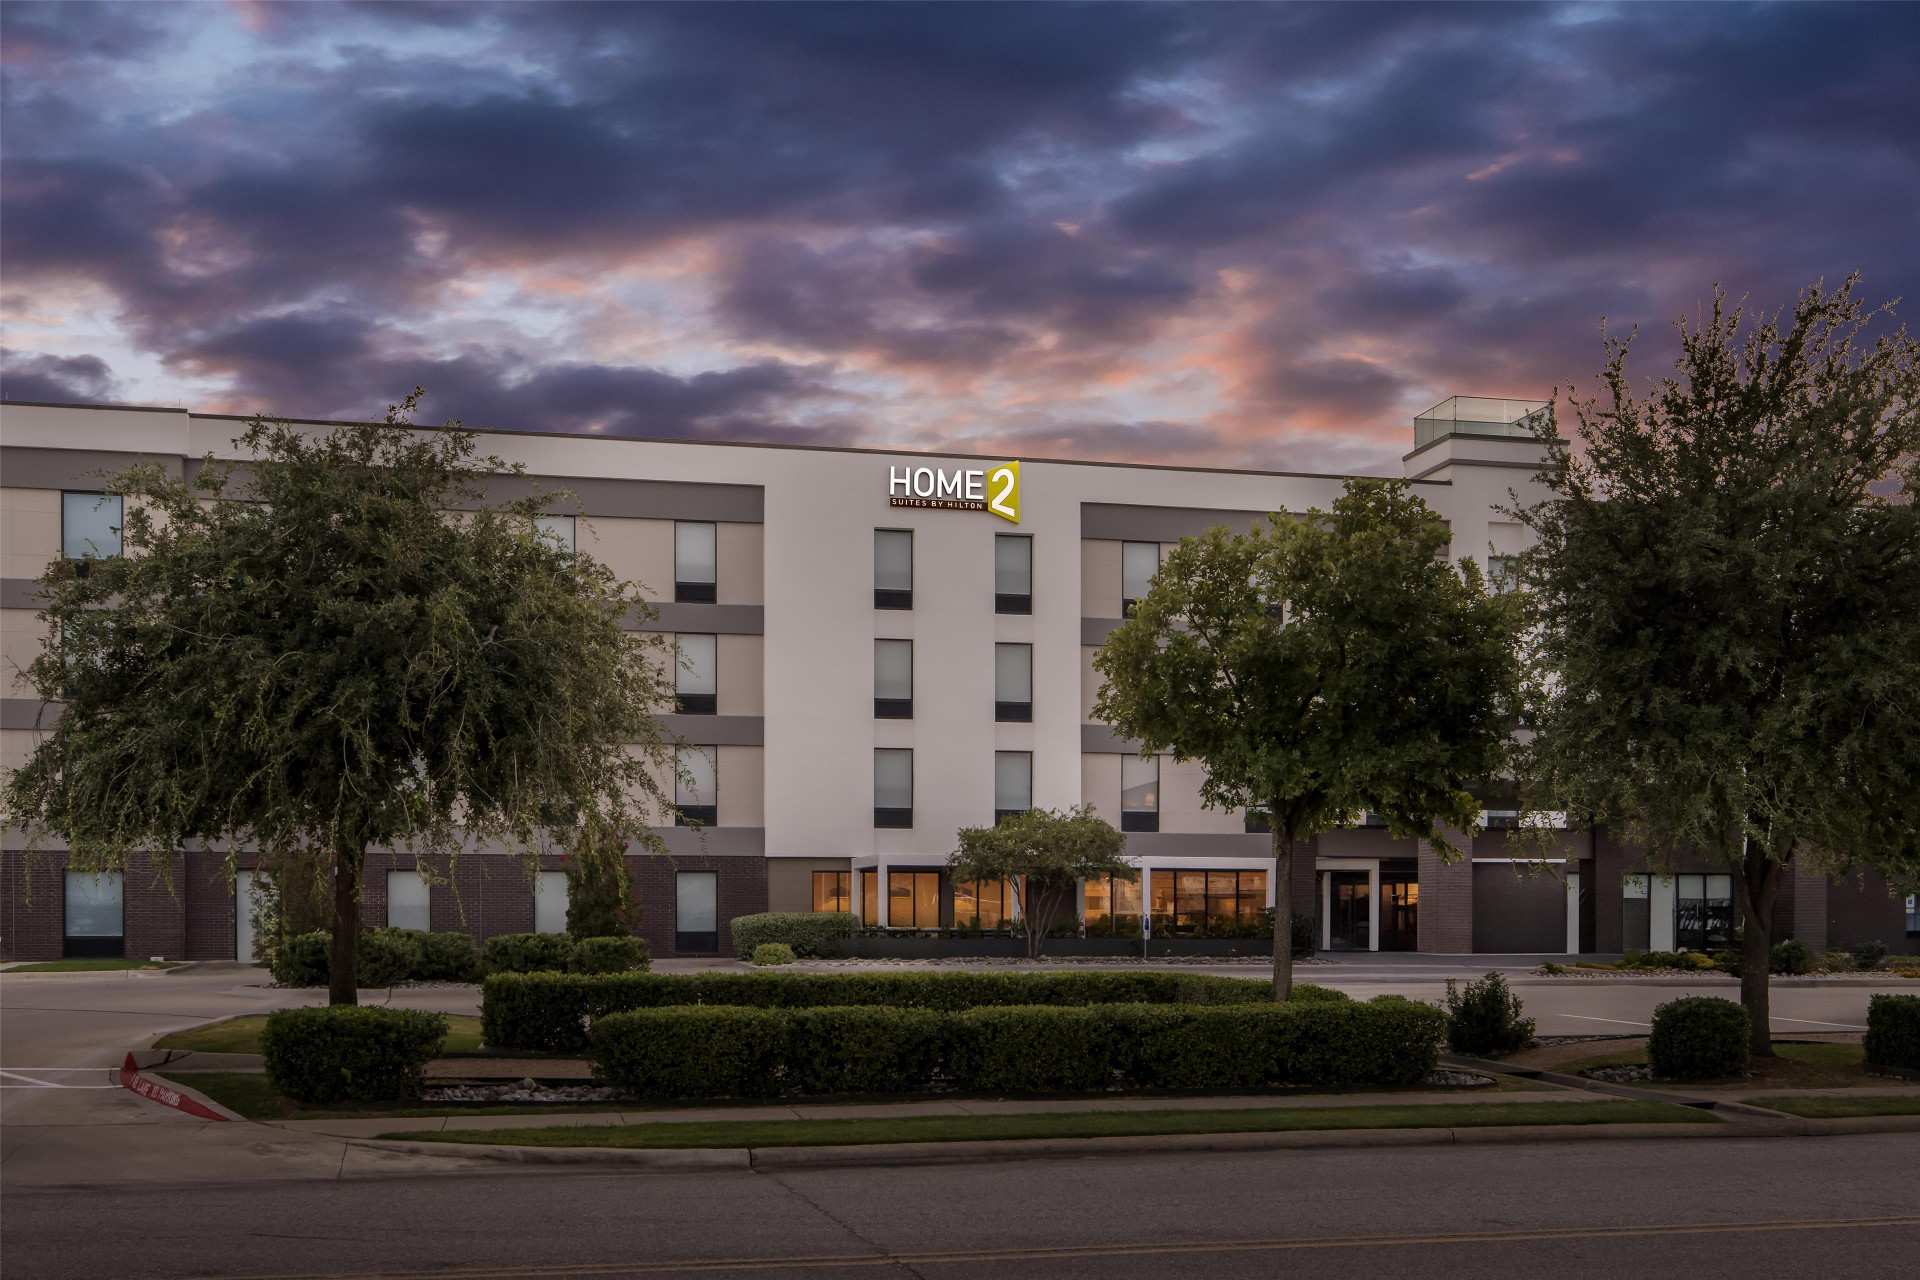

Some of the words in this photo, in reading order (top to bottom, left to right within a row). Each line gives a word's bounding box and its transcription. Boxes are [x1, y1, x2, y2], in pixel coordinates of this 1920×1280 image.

[889, 465, 984, 500] HOME
[991, 468, 1015, 518] 2
[892, 498, 927, 507] SUITES
[931, 500, 943, 508] BY
[947, 501, 983, 509] HILTON
